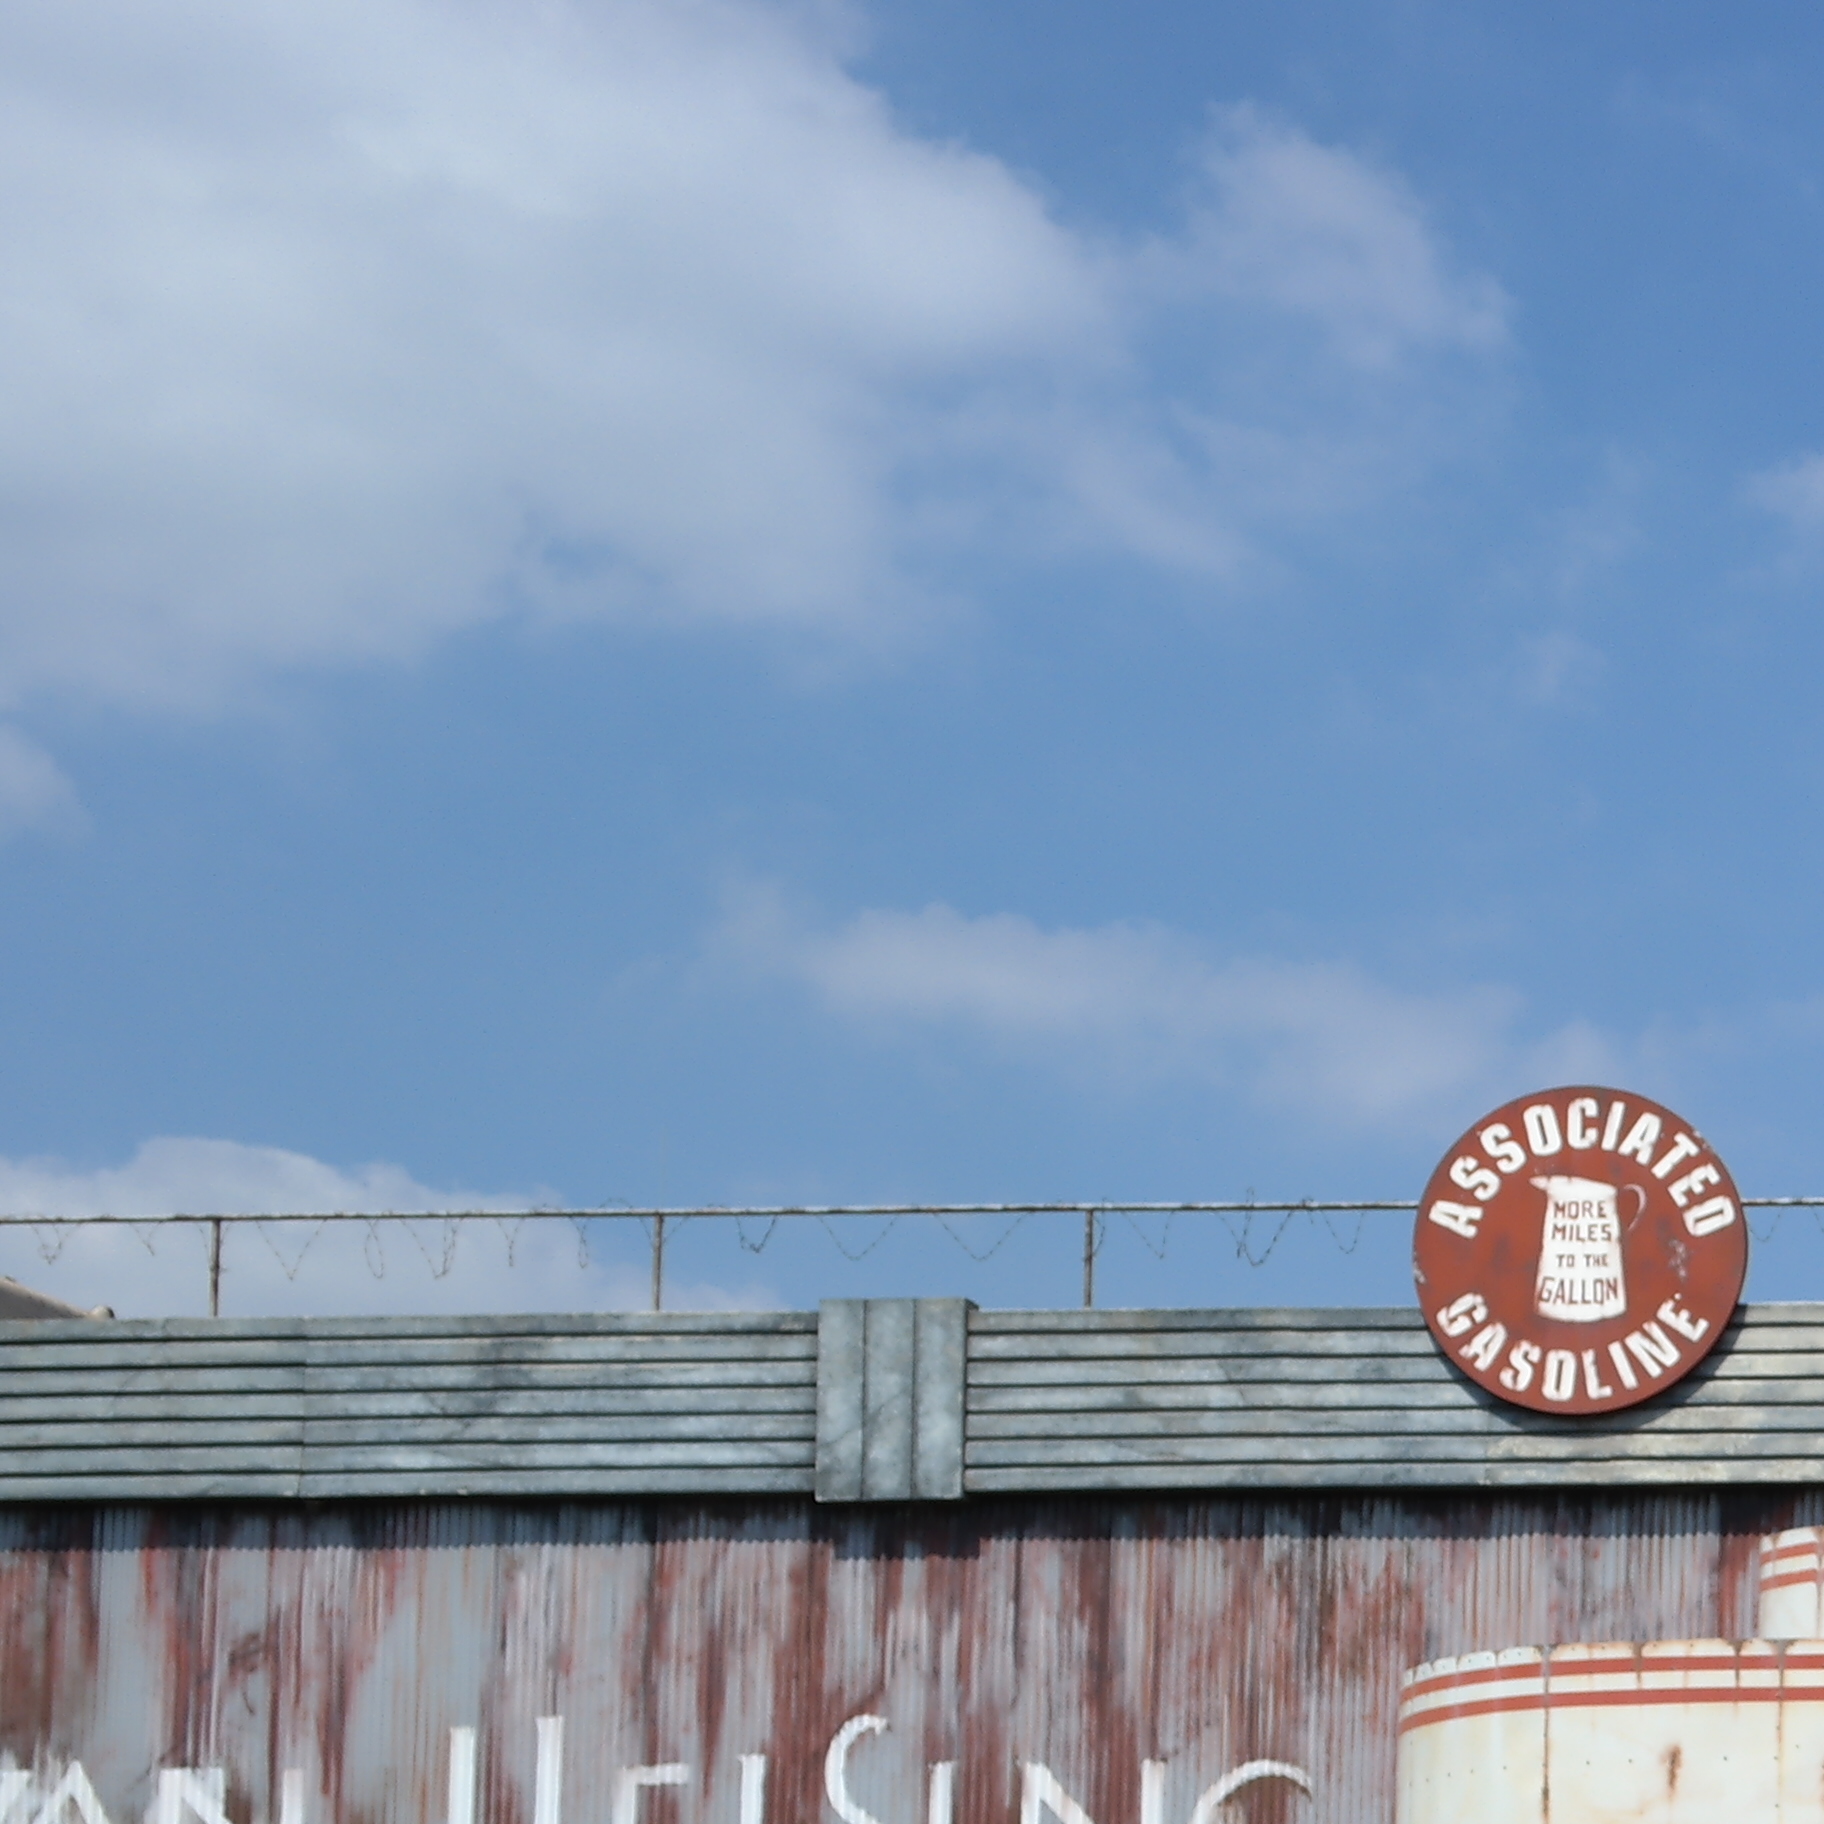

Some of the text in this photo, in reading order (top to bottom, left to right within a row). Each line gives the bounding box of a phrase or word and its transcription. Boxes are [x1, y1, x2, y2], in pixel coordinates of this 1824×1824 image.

[1428, 1097, 1736, 1239] ASSOCIATED
[1553, 1199, 1607, 1220] MORE
[1550, 1223, 1612, 1242] MILES
[1556, 1253, 1608, 1269] TO THE
[1539, 1276, 1619, 1305] GALLON
[1436, 1292, 1710, 1402] GASOLINE
